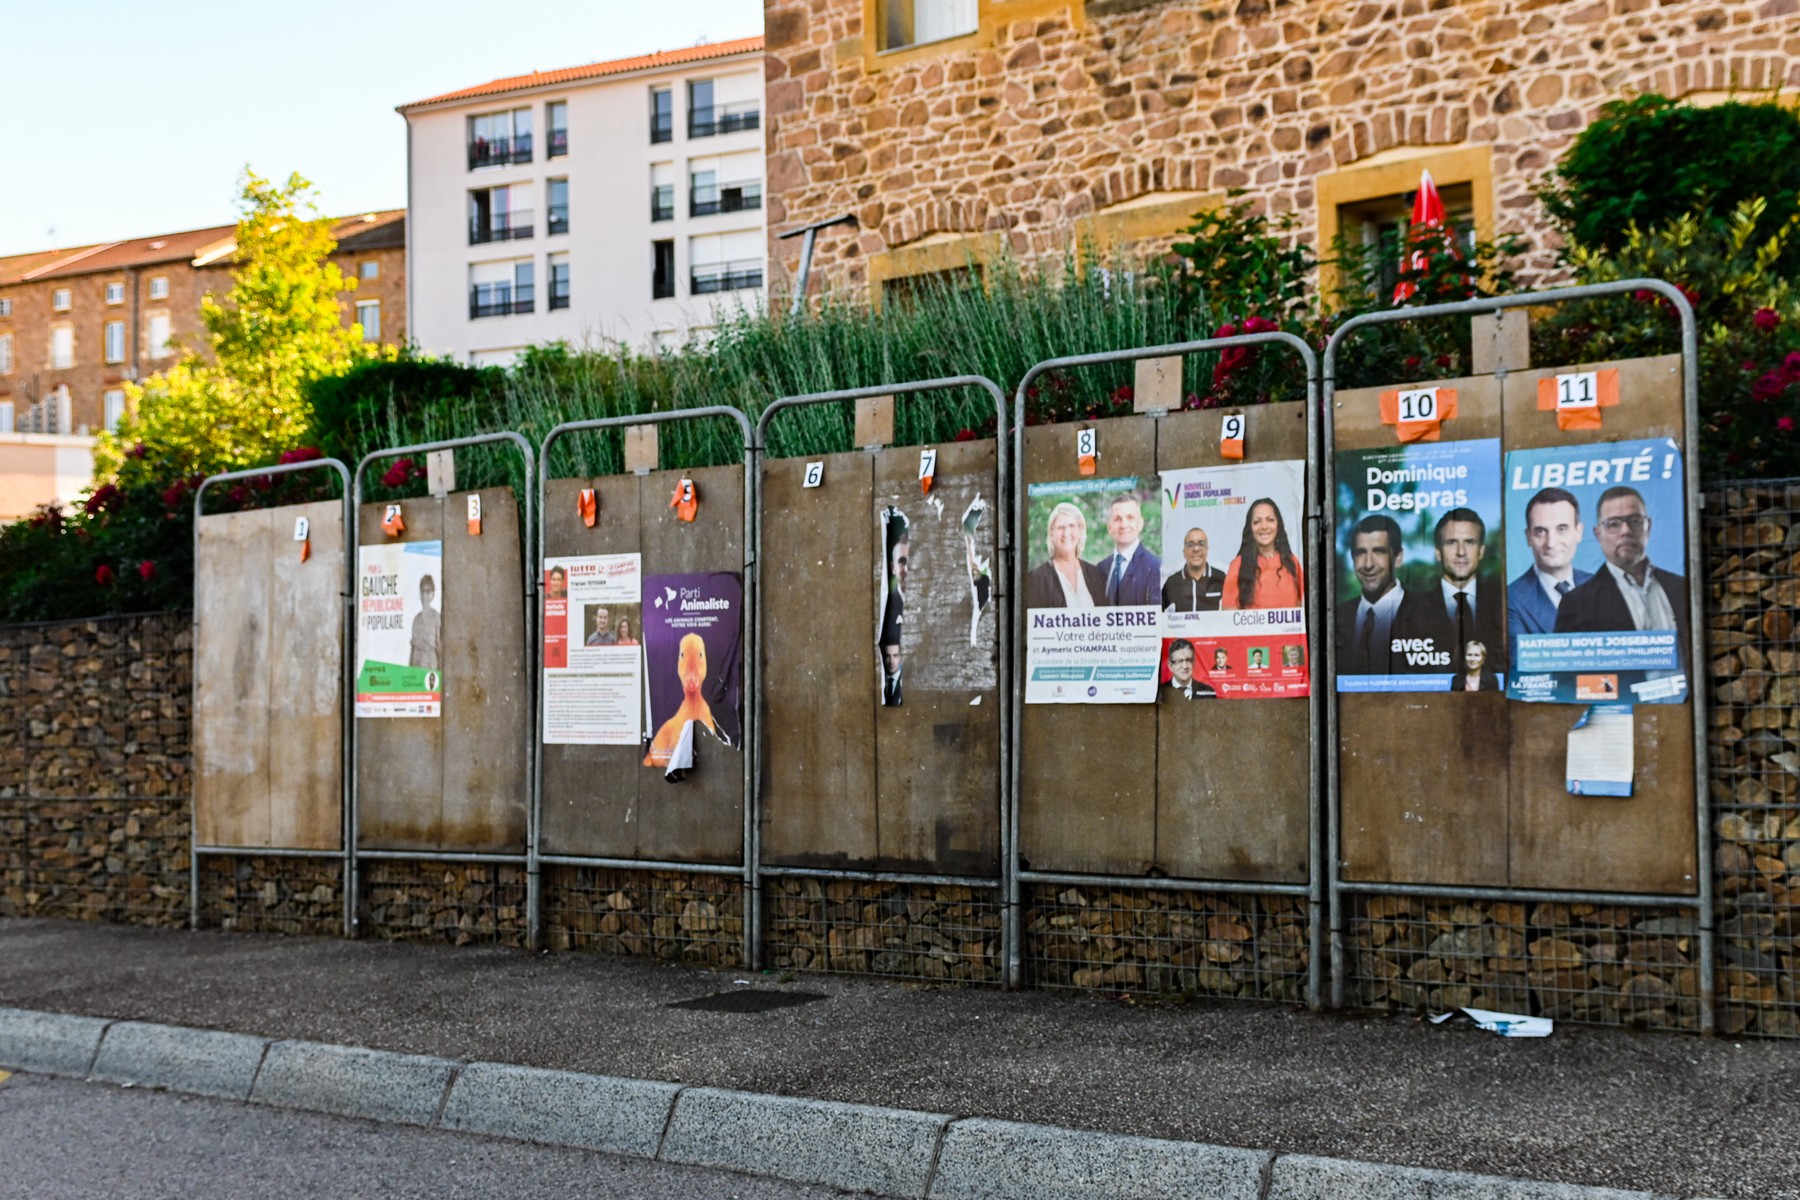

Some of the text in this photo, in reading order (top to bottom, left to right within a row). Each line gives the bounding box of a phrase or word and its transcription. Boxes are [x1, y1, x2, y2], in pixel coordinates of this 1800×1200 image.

[1560, 377, 1593, 404] 11
[1402, 394, 1433, 419] 10
[1226, 417, 1240, 439] 9
[1080, 433, 1092, 454] 8
[922, 456, 932, 476] 7
[1367, 463, 1468, 485] Dominique
[1512, 447, 1675, 491] LIBERTÉ !
[808, 466, 819, 484] 6
[1184, 482, 1212, 491] NOUVELLE
[1184, 488, 1232, 499] UNION POPULAIRE
[472, 500, 479, 517] 3
[1224, 496, 1246, 505] SOCIALE
[1367, 488, 1468, 514] Despras
[386, 507, 397, 523] 2
[298, 521, 304, 537] 1
[362, 574, 398, 597] GAUCHE
[680, 586, 700, 600] Parti
[680, 597, 730, 611] Animaliste
[367, 613, 404, 630] POPULAIRE
[1033, 611, 1157, 628] Nathalie SERRE
[1233, 610, 1265, 626] Cécile
[1055, 630, 1133, 643] Votre députée
[1520, 635, 1675, 649] MATHIEU NOVE JOSSERAND
[1041, 646, 1072, 655] Aymeric
[1120, 644, 1157, 654] suppléant
[1391, 638, 1434, 653] avec
[1552, 650, 1583, 658] soutien
[1584, 649, 1595, 657] de
[1406, 652, 1451, 666] vous
